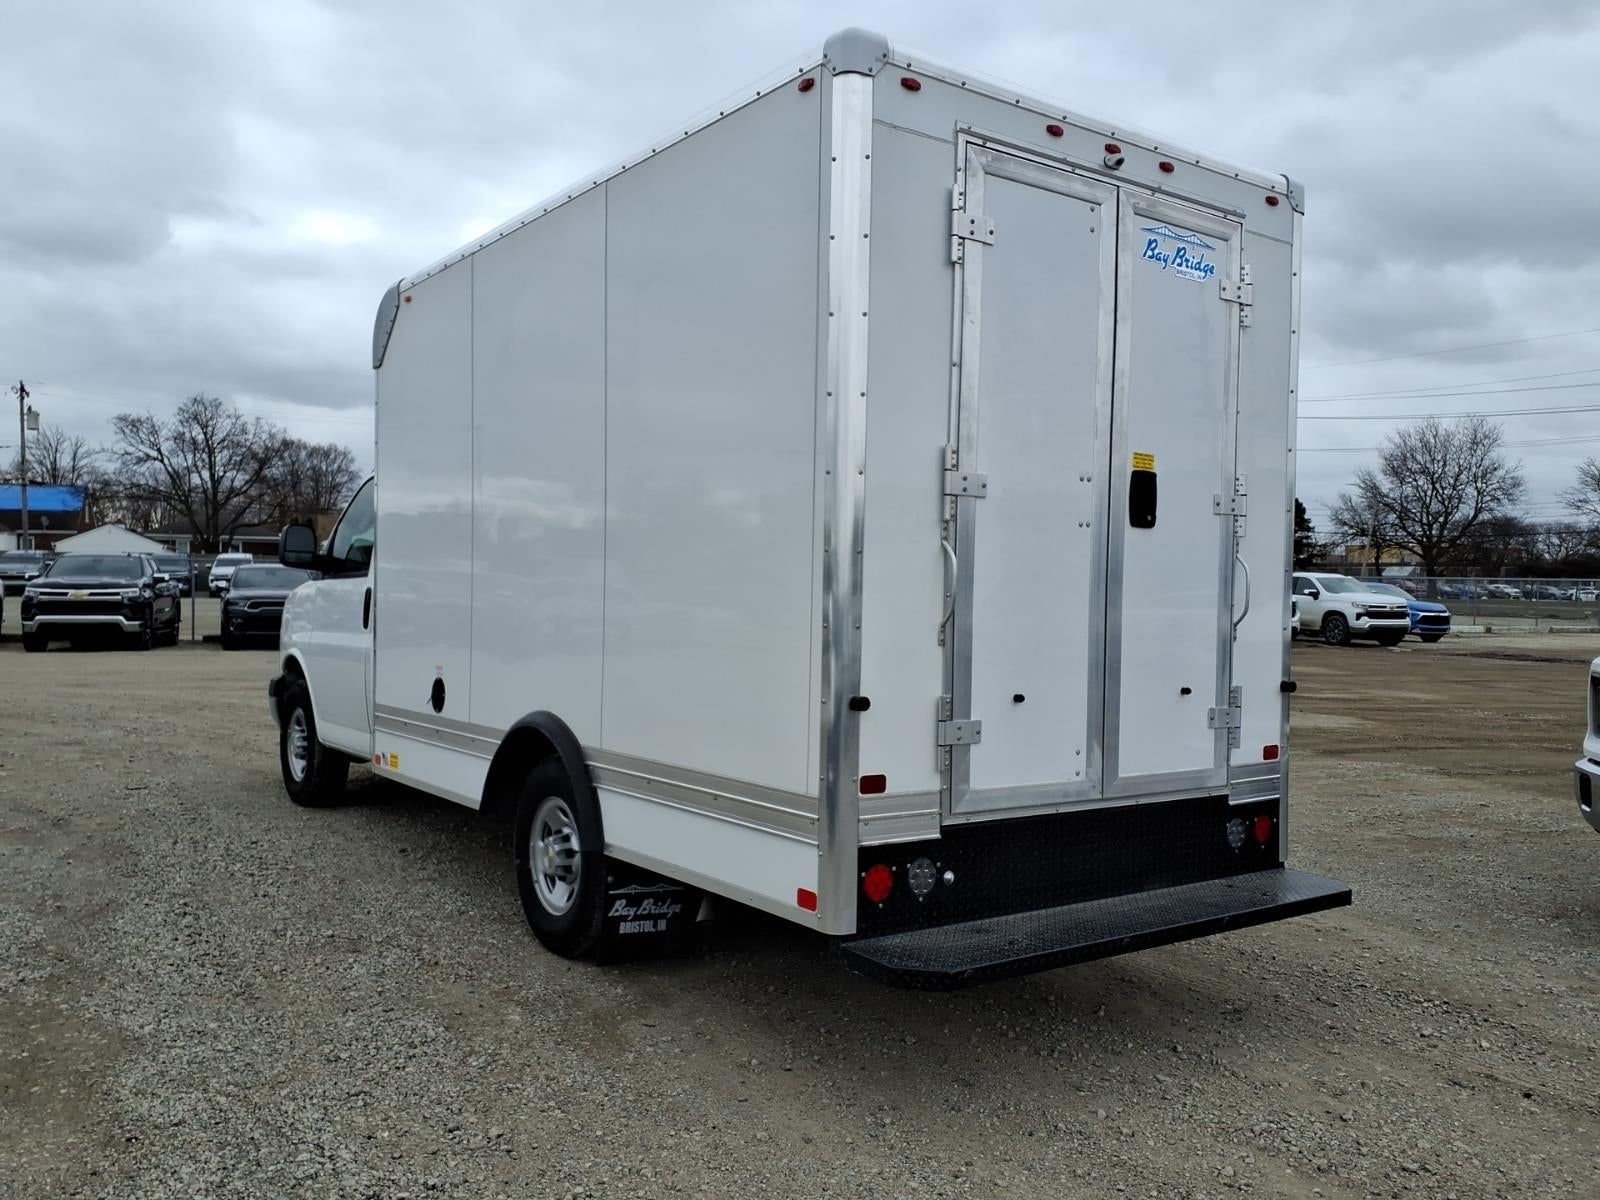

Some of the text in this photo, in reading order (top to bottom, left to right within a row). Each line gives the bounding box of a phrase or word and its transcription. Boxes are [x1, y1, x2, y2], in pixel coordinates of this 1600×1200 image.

[1142, 238, 1215, 279] Bay Bridge
[608, 898, 682, 920] Bay Bridge
[657, 919, 667, 931] IN
